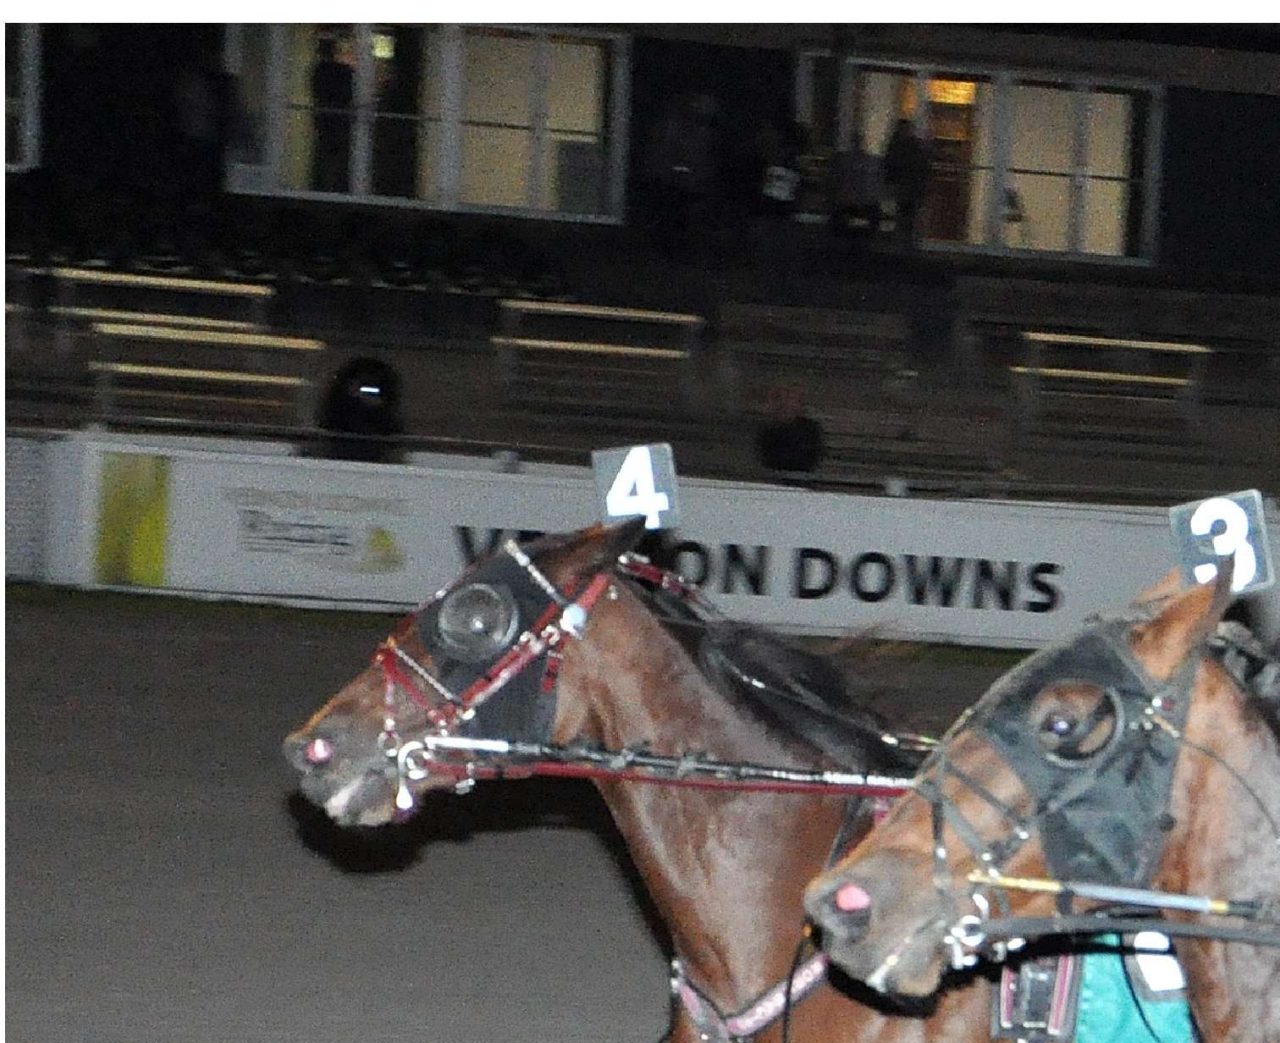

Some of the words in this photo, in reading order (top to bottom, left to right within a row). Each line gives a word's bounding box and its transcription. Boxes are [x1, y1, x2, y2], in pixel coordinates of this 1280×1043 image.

[606, 446, 669, 529] 4
[790, 547, 1064, 613] DOWNS
[1190, 497, 1256, 592] 3
